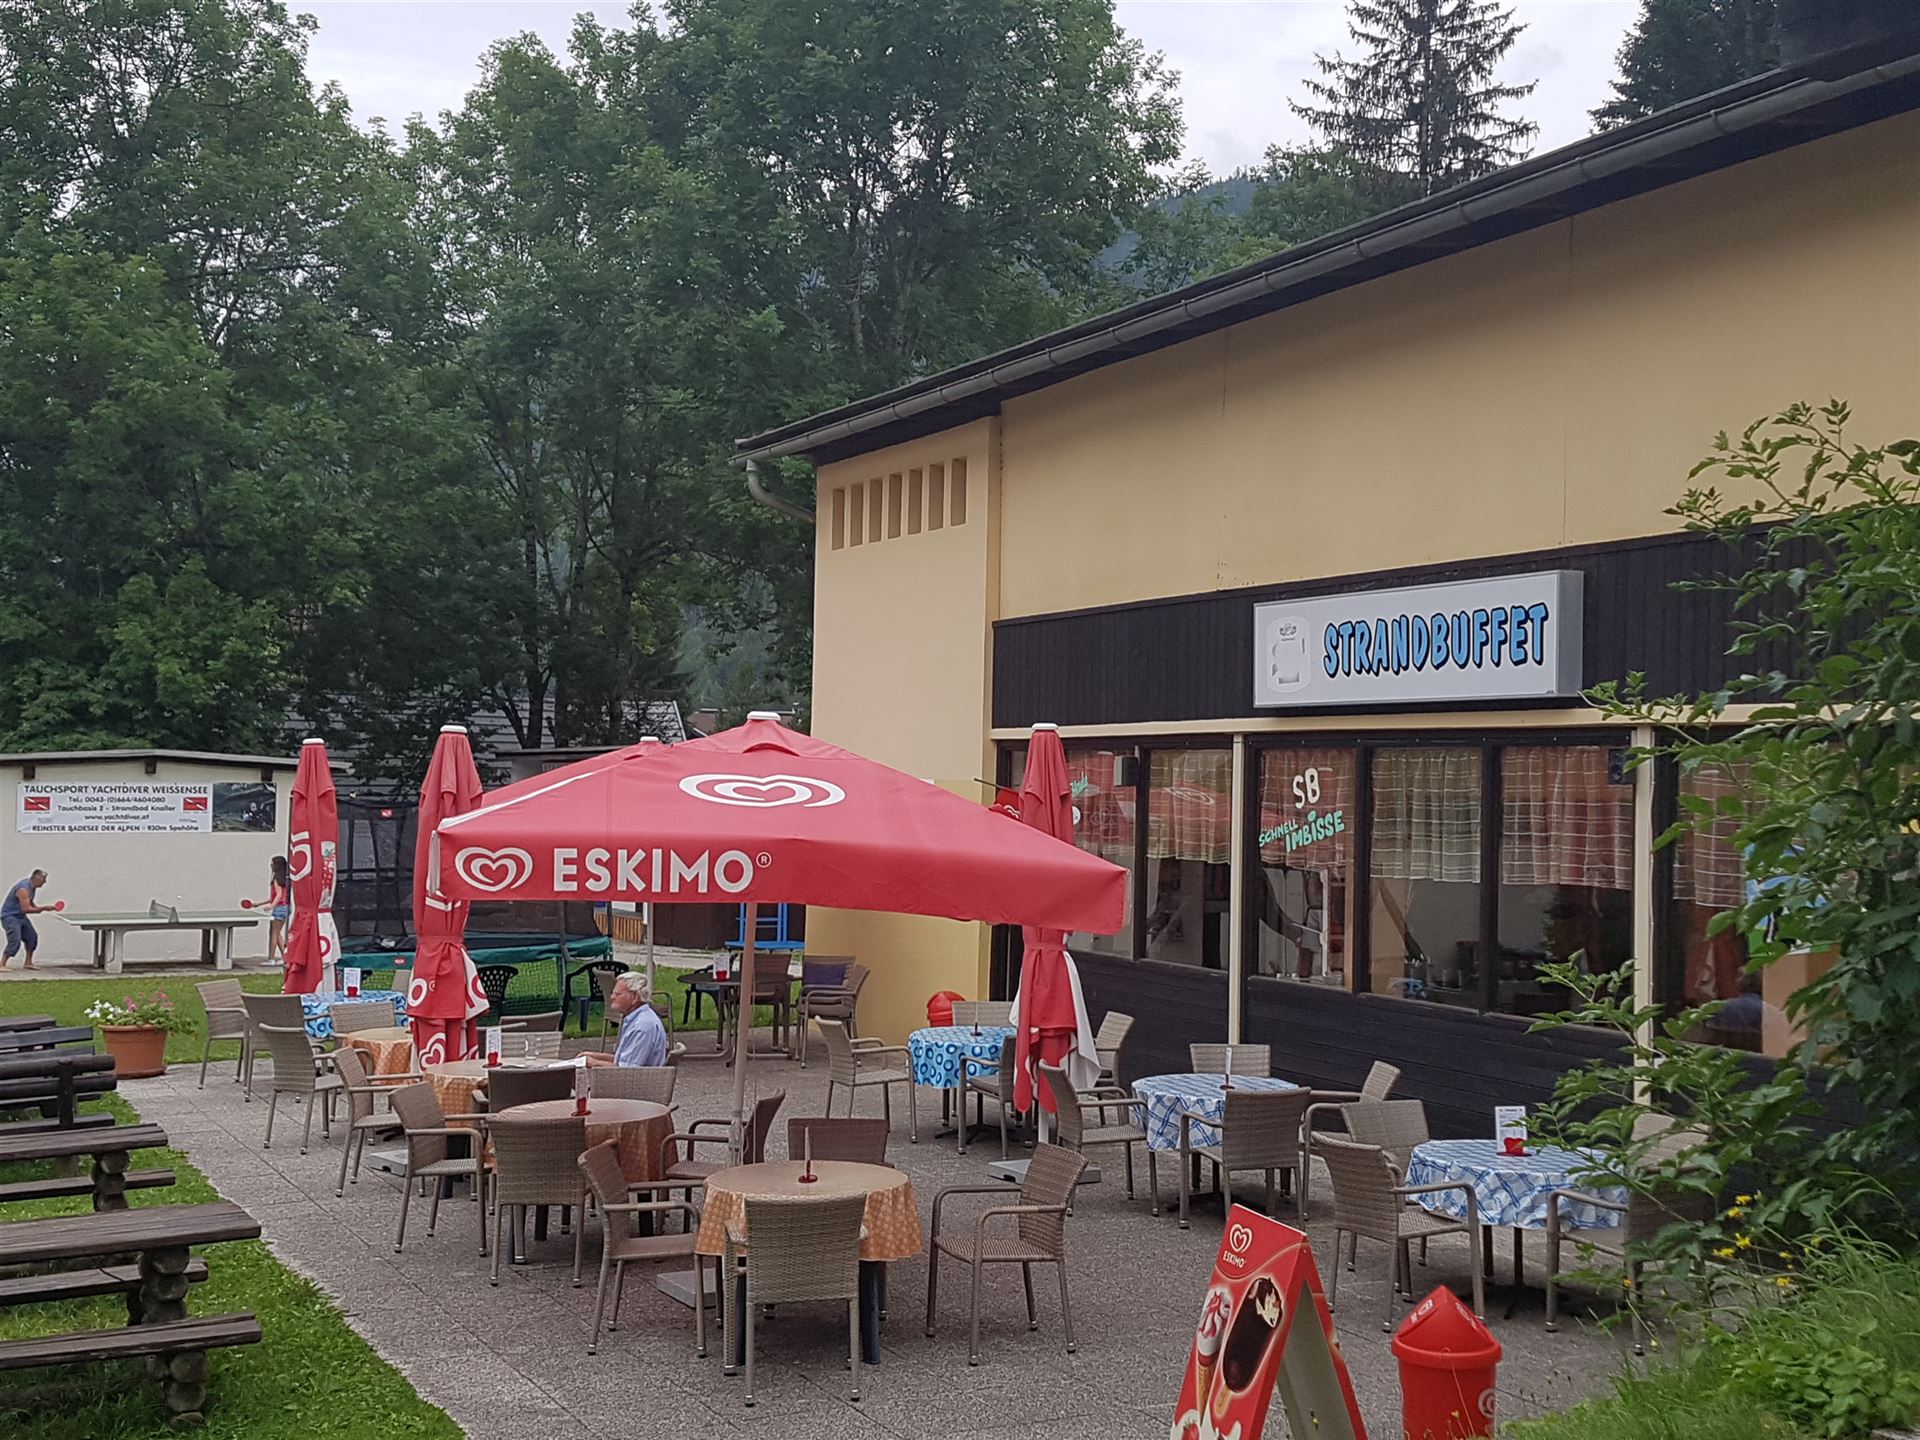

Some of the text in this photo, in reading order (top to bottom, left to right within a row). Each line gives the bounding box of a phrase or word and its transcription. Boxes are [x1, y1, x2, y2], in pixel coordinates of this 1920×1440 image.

[1323, 602, 1549, 678] STRANDBUFFET
[24, 785, 208, 794] TAUCHSPORT YACHTDIVER WEISSENSEE
[1292, 767, 1321, 809] SB
[1258, 818, 1298, 847] SCHNELL
